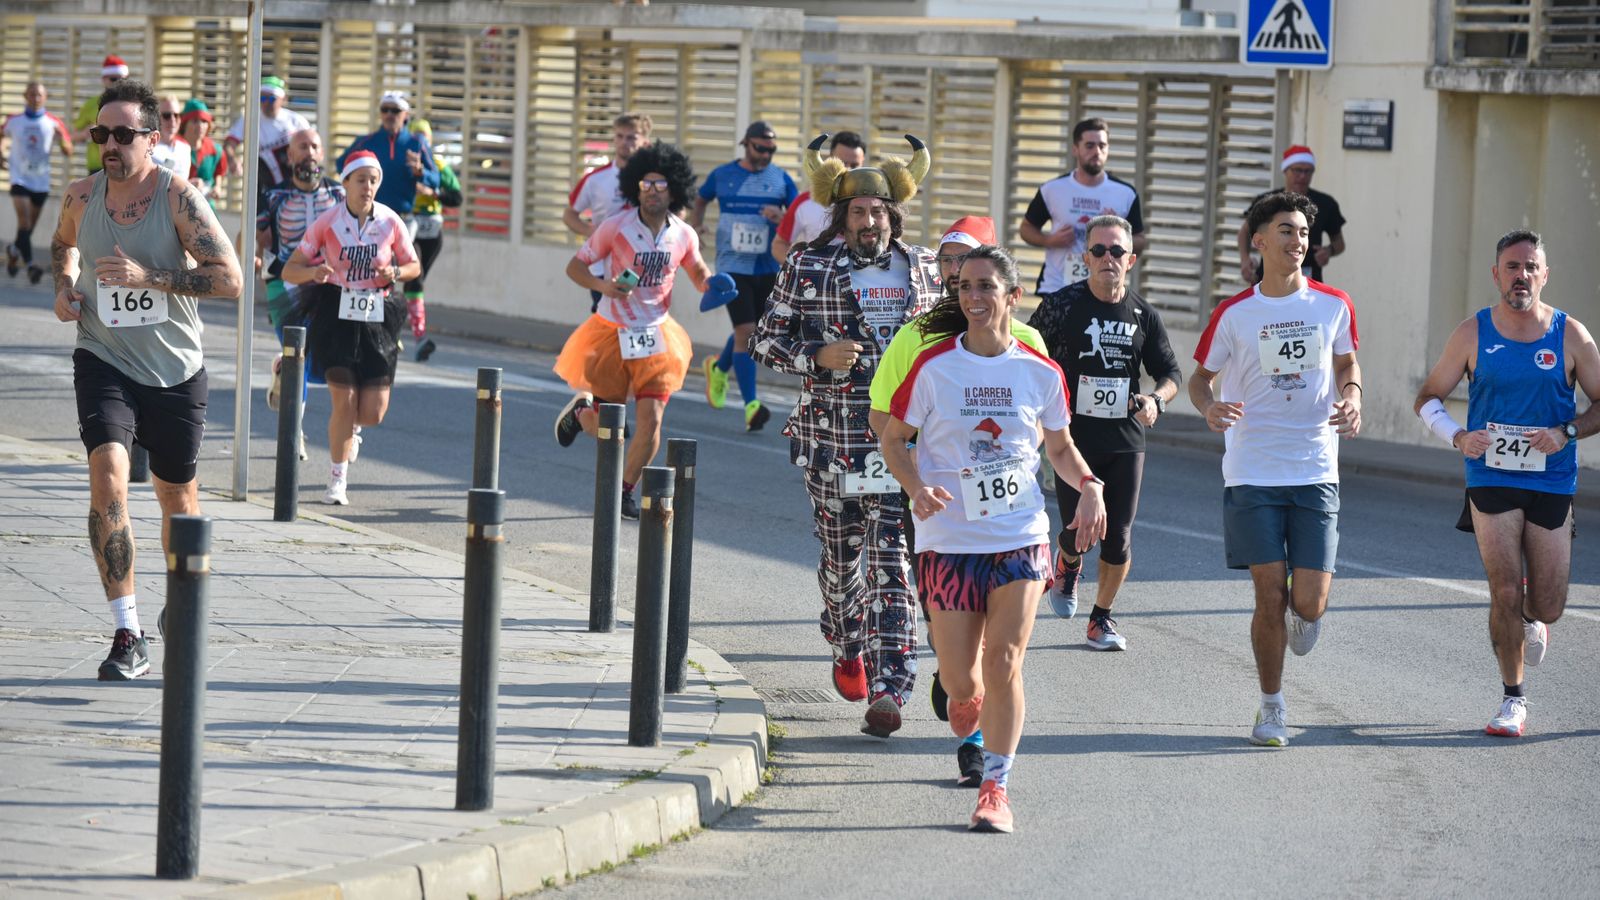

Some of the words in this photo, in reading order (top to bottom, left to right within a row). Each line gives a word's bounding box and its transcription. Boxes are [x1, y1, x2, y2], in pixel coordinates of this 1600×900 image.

[739, 232, 762, 246] 116
[339, 243, 377, 261] CORRO
[633, 251, 671, 267] CORRO
[111, 290, 154, 312] 166
[1103, 320, 1138, 336] XIV
[1288, 326, 1319, 334] SILVESTRE
[629, 334, 656, 349] 145
[1278, 340, 1306, 360] 45
[964, 387, 971, 398] II
[972, 387, 1013, 399] CARRERA
[1094, 389, 1117, 406] 90
[965, 398, 979, 407] SAN
[980, 398, 1013, 407] SILVESTRE
[1496, 437, 1531, 458] 247
[977, 474, 1019, 502] 186
